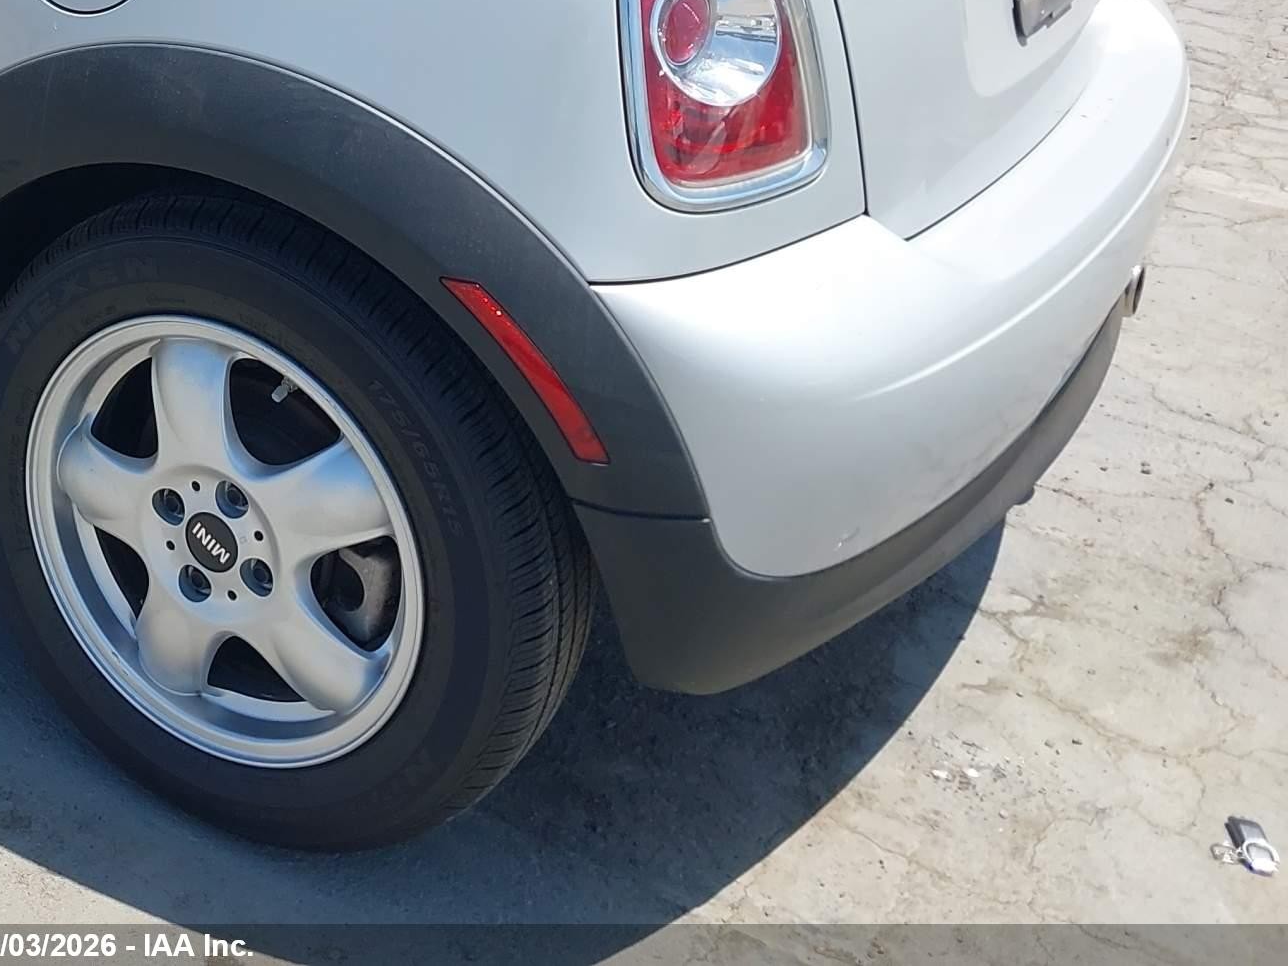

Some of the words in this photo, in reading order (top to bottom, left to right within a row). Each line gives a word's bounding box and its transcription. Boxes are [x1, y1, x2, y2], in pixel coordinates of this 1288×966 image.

[4, 257, 161, 354] NEXEN
[366, 377, 465, 539] 175/65R15
[192, 521, 231, 565] MINI
